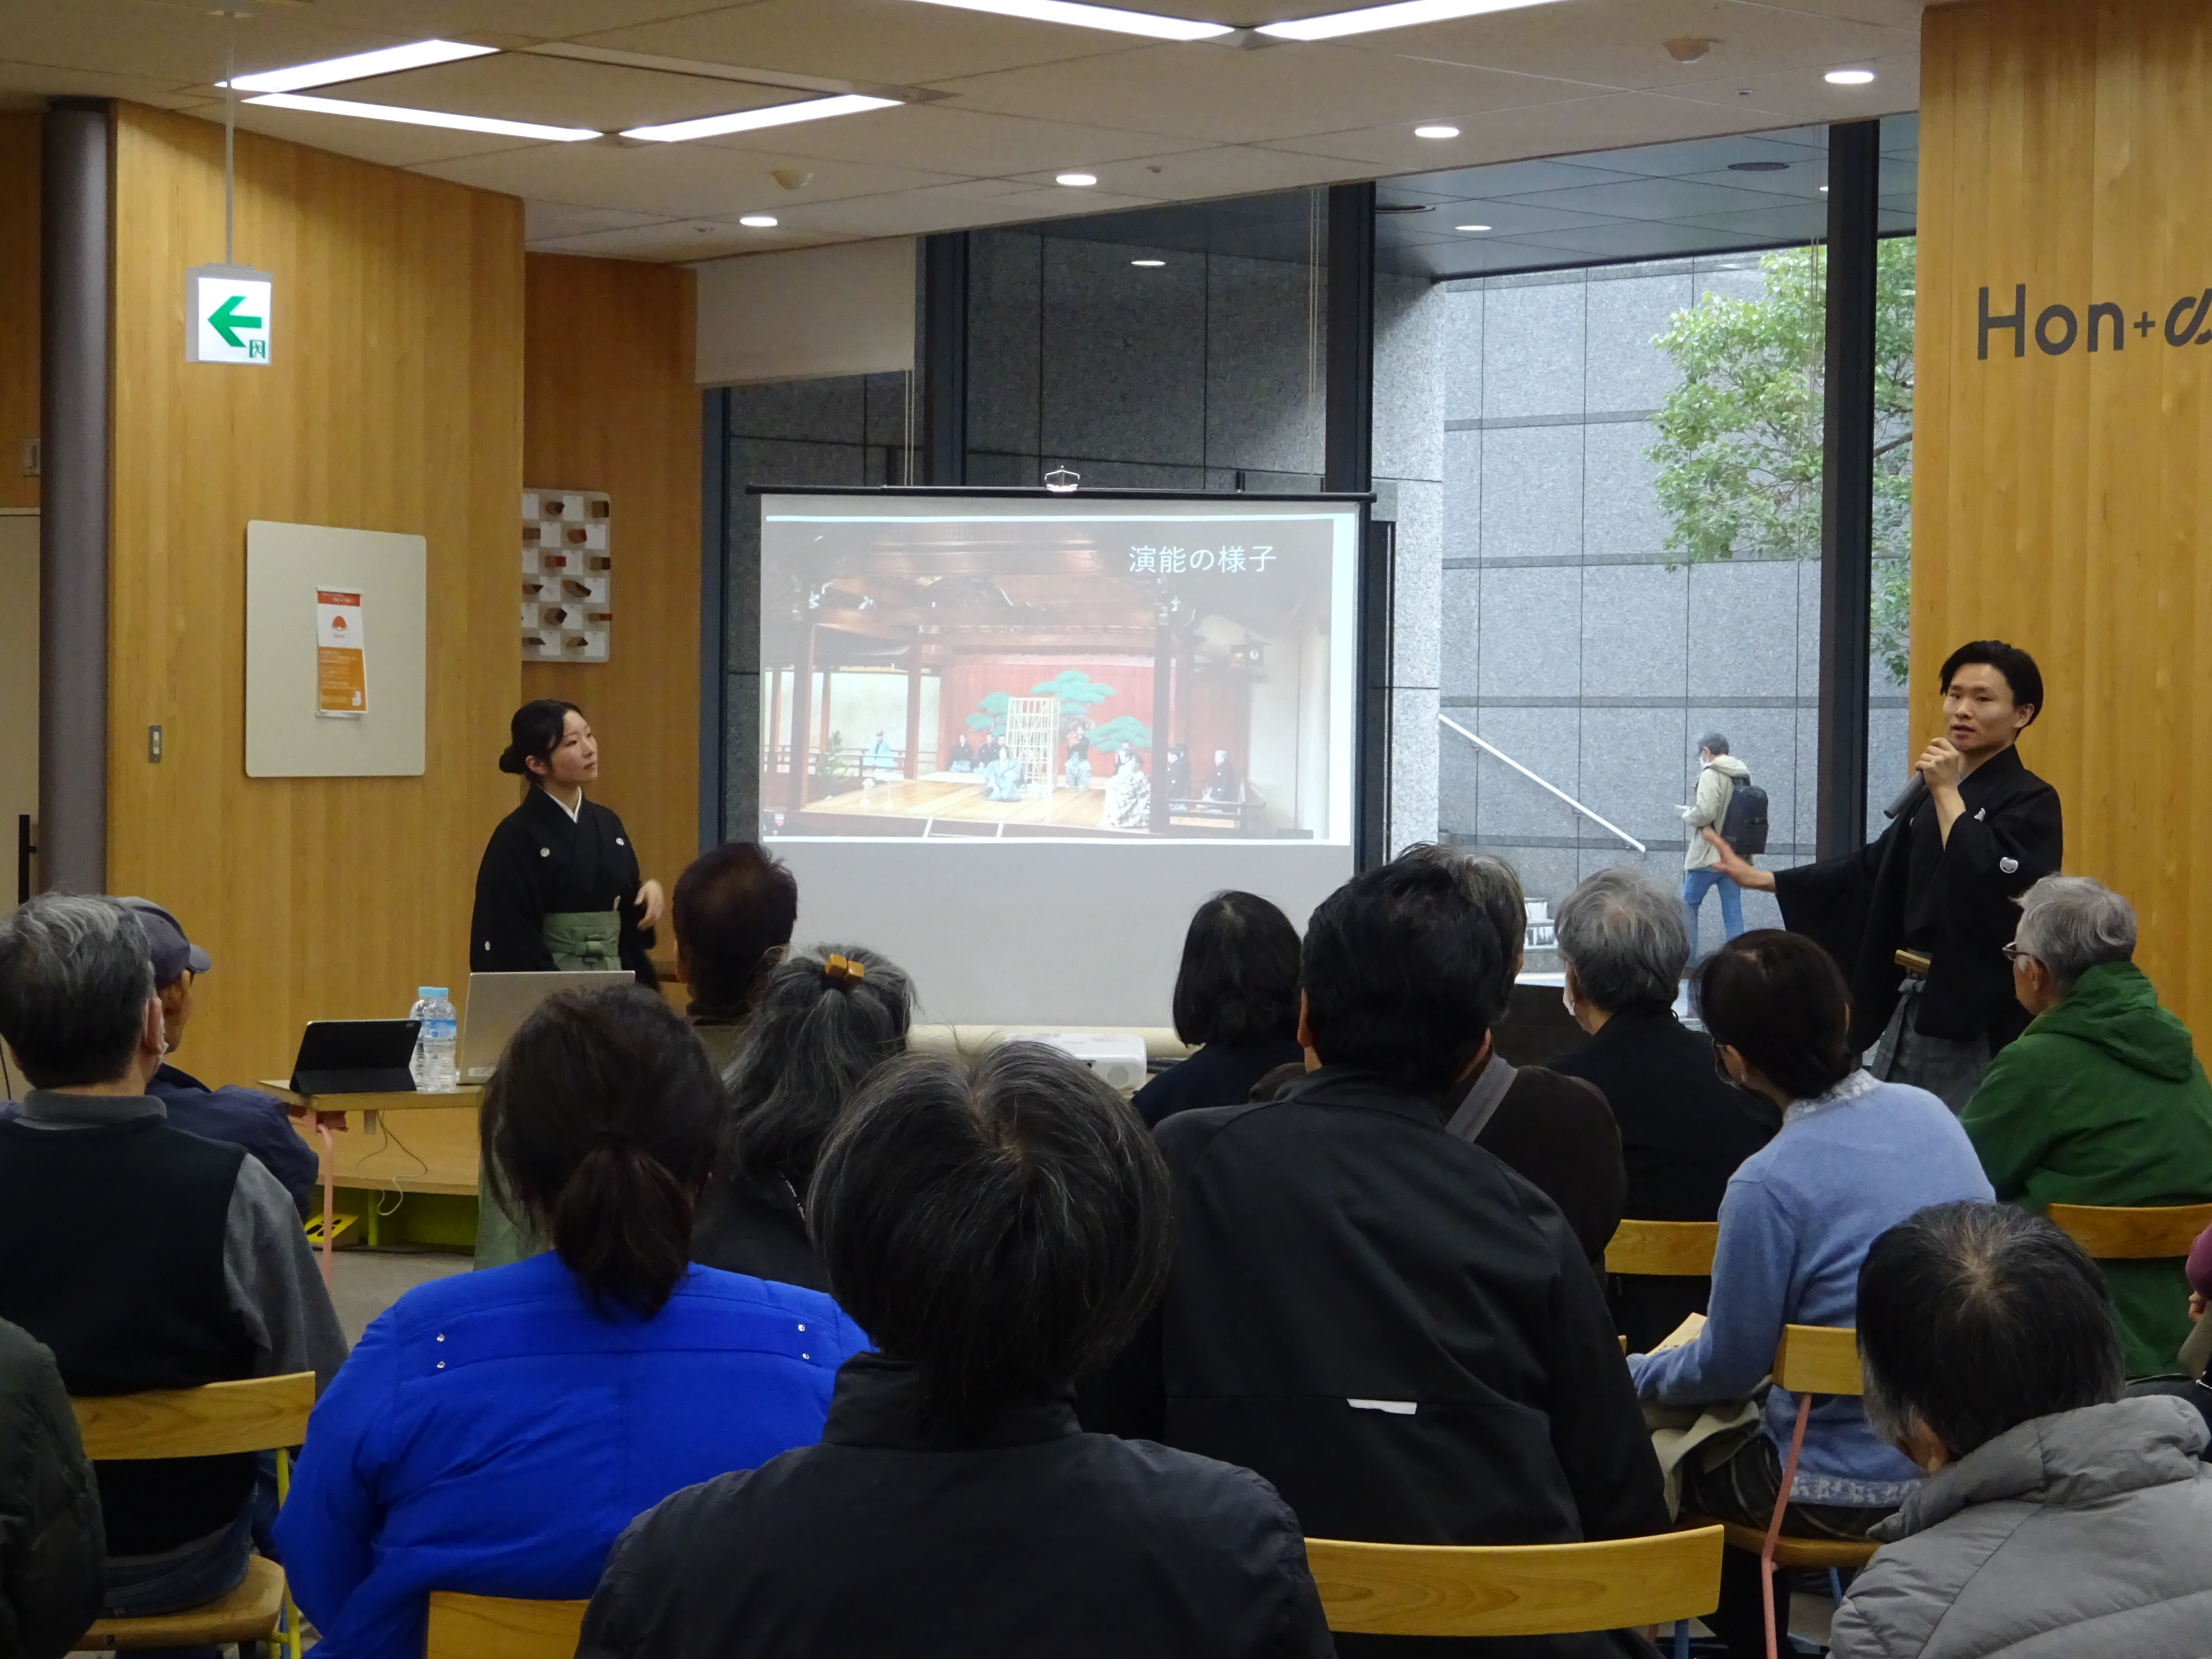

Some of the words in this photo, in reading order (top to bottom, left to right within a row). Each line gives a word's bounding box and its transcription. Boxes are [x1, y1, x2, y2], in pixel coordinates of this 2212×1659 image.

[1129, 545, 1276, 573] 演能の様子
